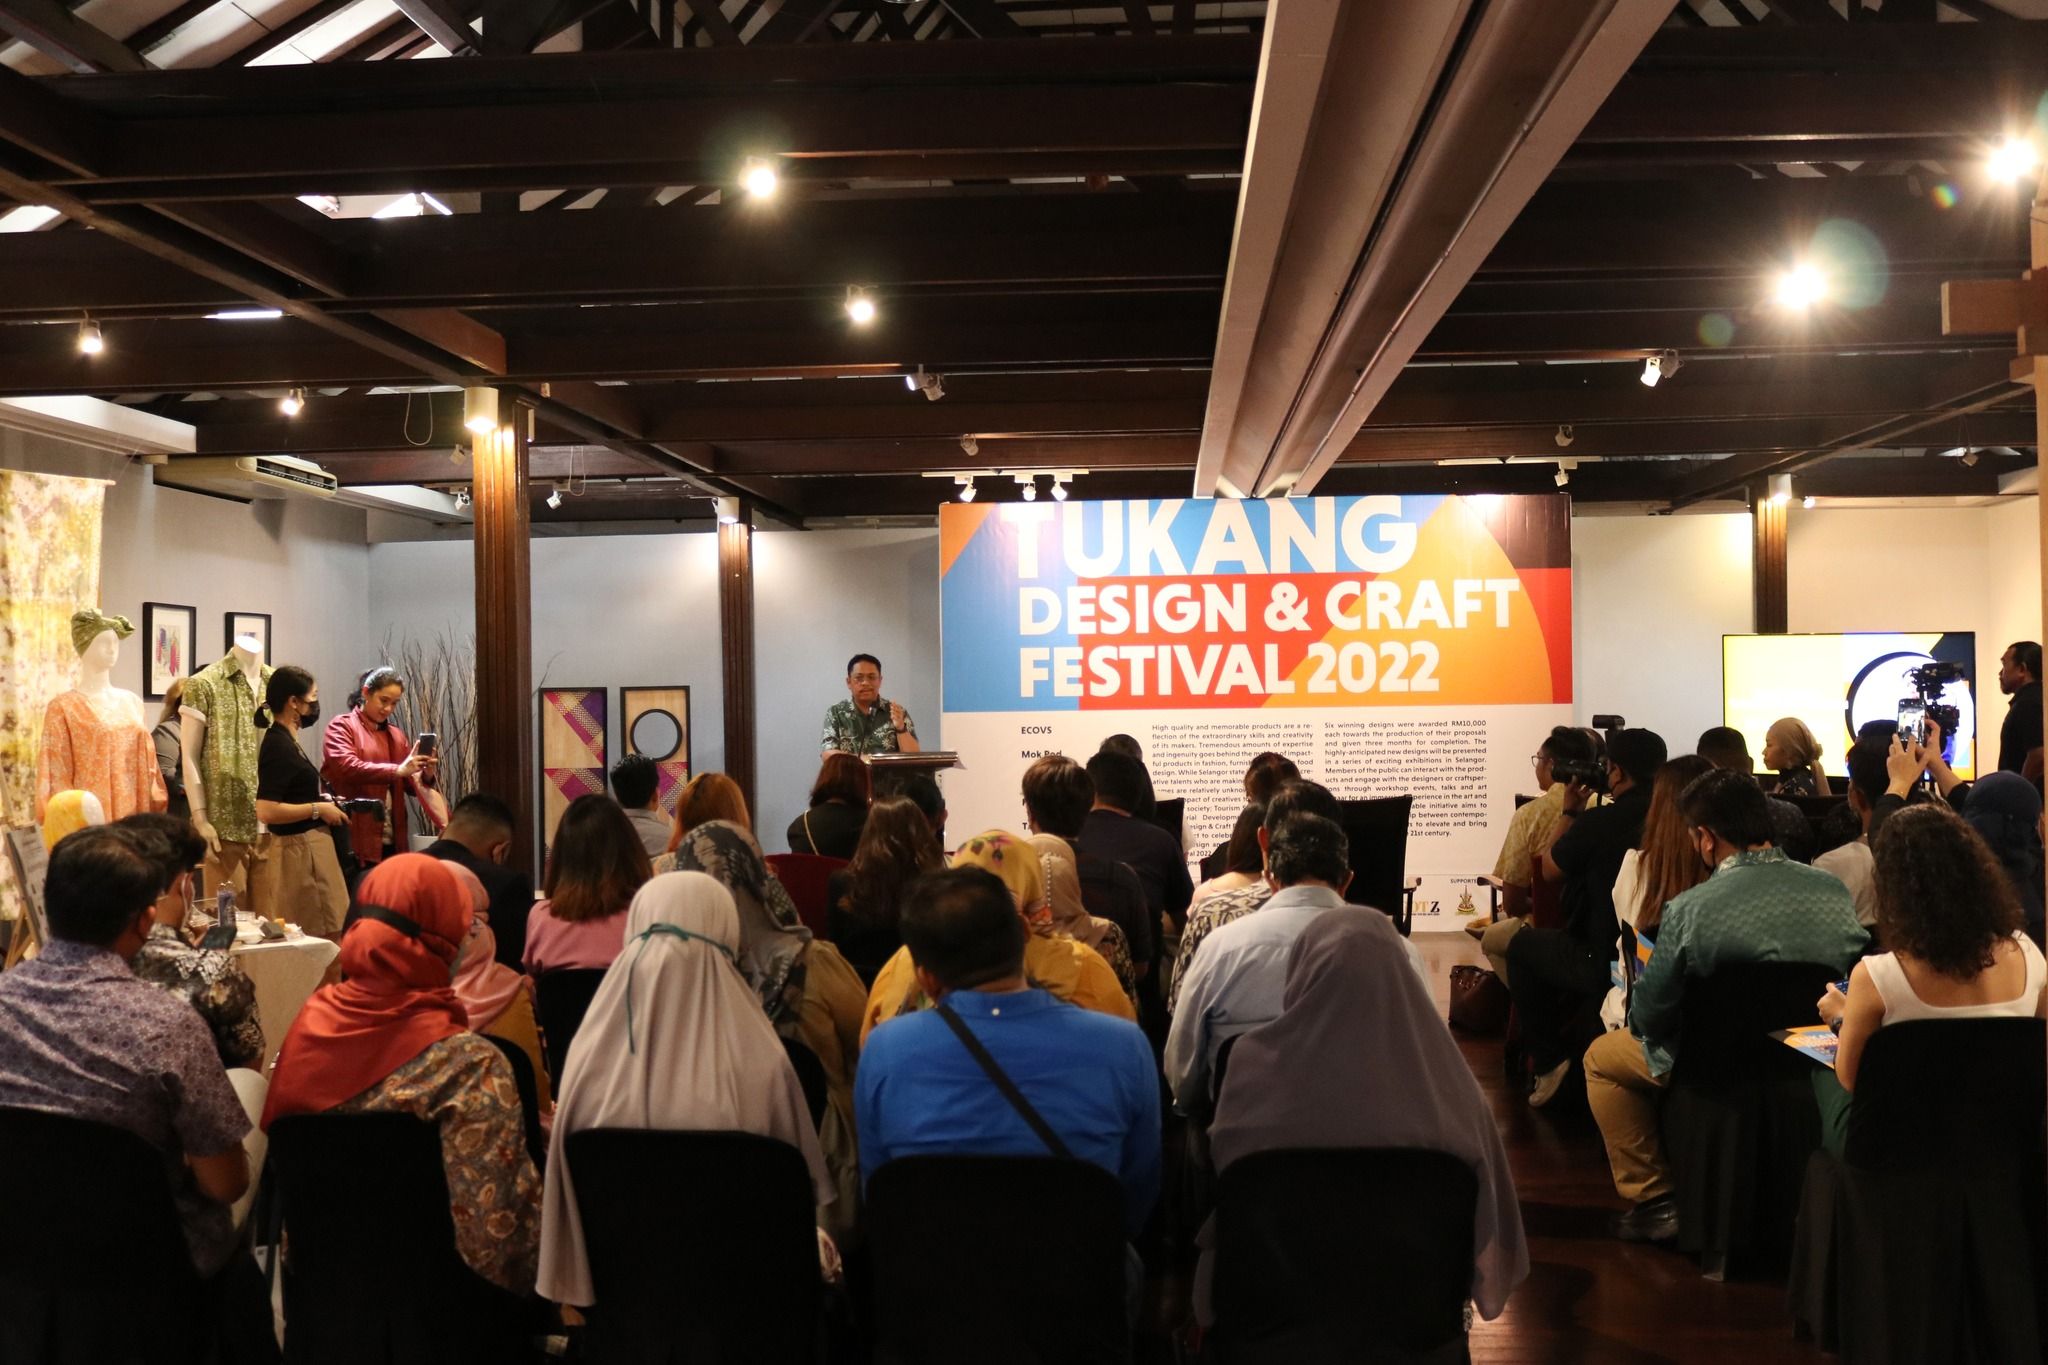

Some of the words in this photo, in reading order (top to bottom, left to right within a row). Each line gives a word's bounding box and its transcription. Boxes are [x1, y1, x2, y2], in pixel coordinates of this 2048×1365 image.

[1001, 495, 1417, 579] TUKANG
[1019, 583, 1247, 635] DESIGN
[1264, 582, 1312, 632] &
[1325, 578, 1520, 631] CRAFT
[1020, 643, 1295, 697] FESTIVAL
[1307, 640, 1440, 693] 2022
[1021, 726, 1053, 735] ECOVS
[1021, 750, 1041, 758] Mok
